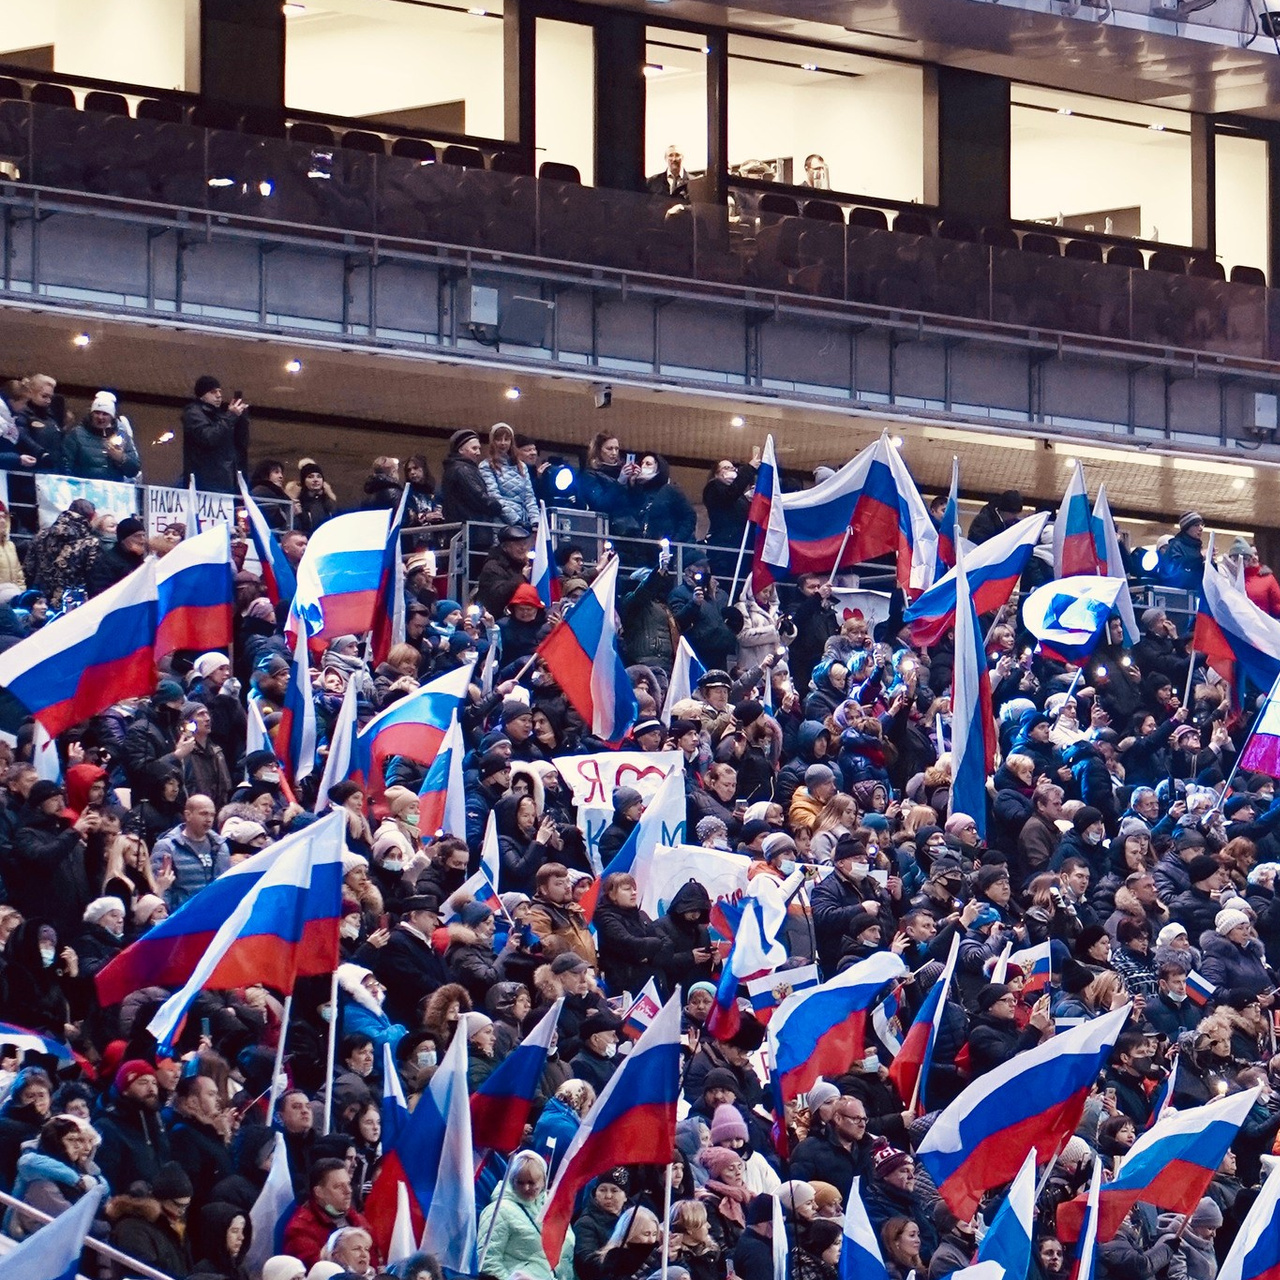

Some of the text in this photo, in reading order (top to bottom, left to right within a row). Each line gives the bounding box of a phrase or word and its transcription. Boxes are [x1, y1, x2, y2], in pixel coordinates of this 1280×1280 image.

[150, 489, 183, 513] НАША
[196, 492, 233, 520] ИЛА-
[577, 759, 606, 803] Я
